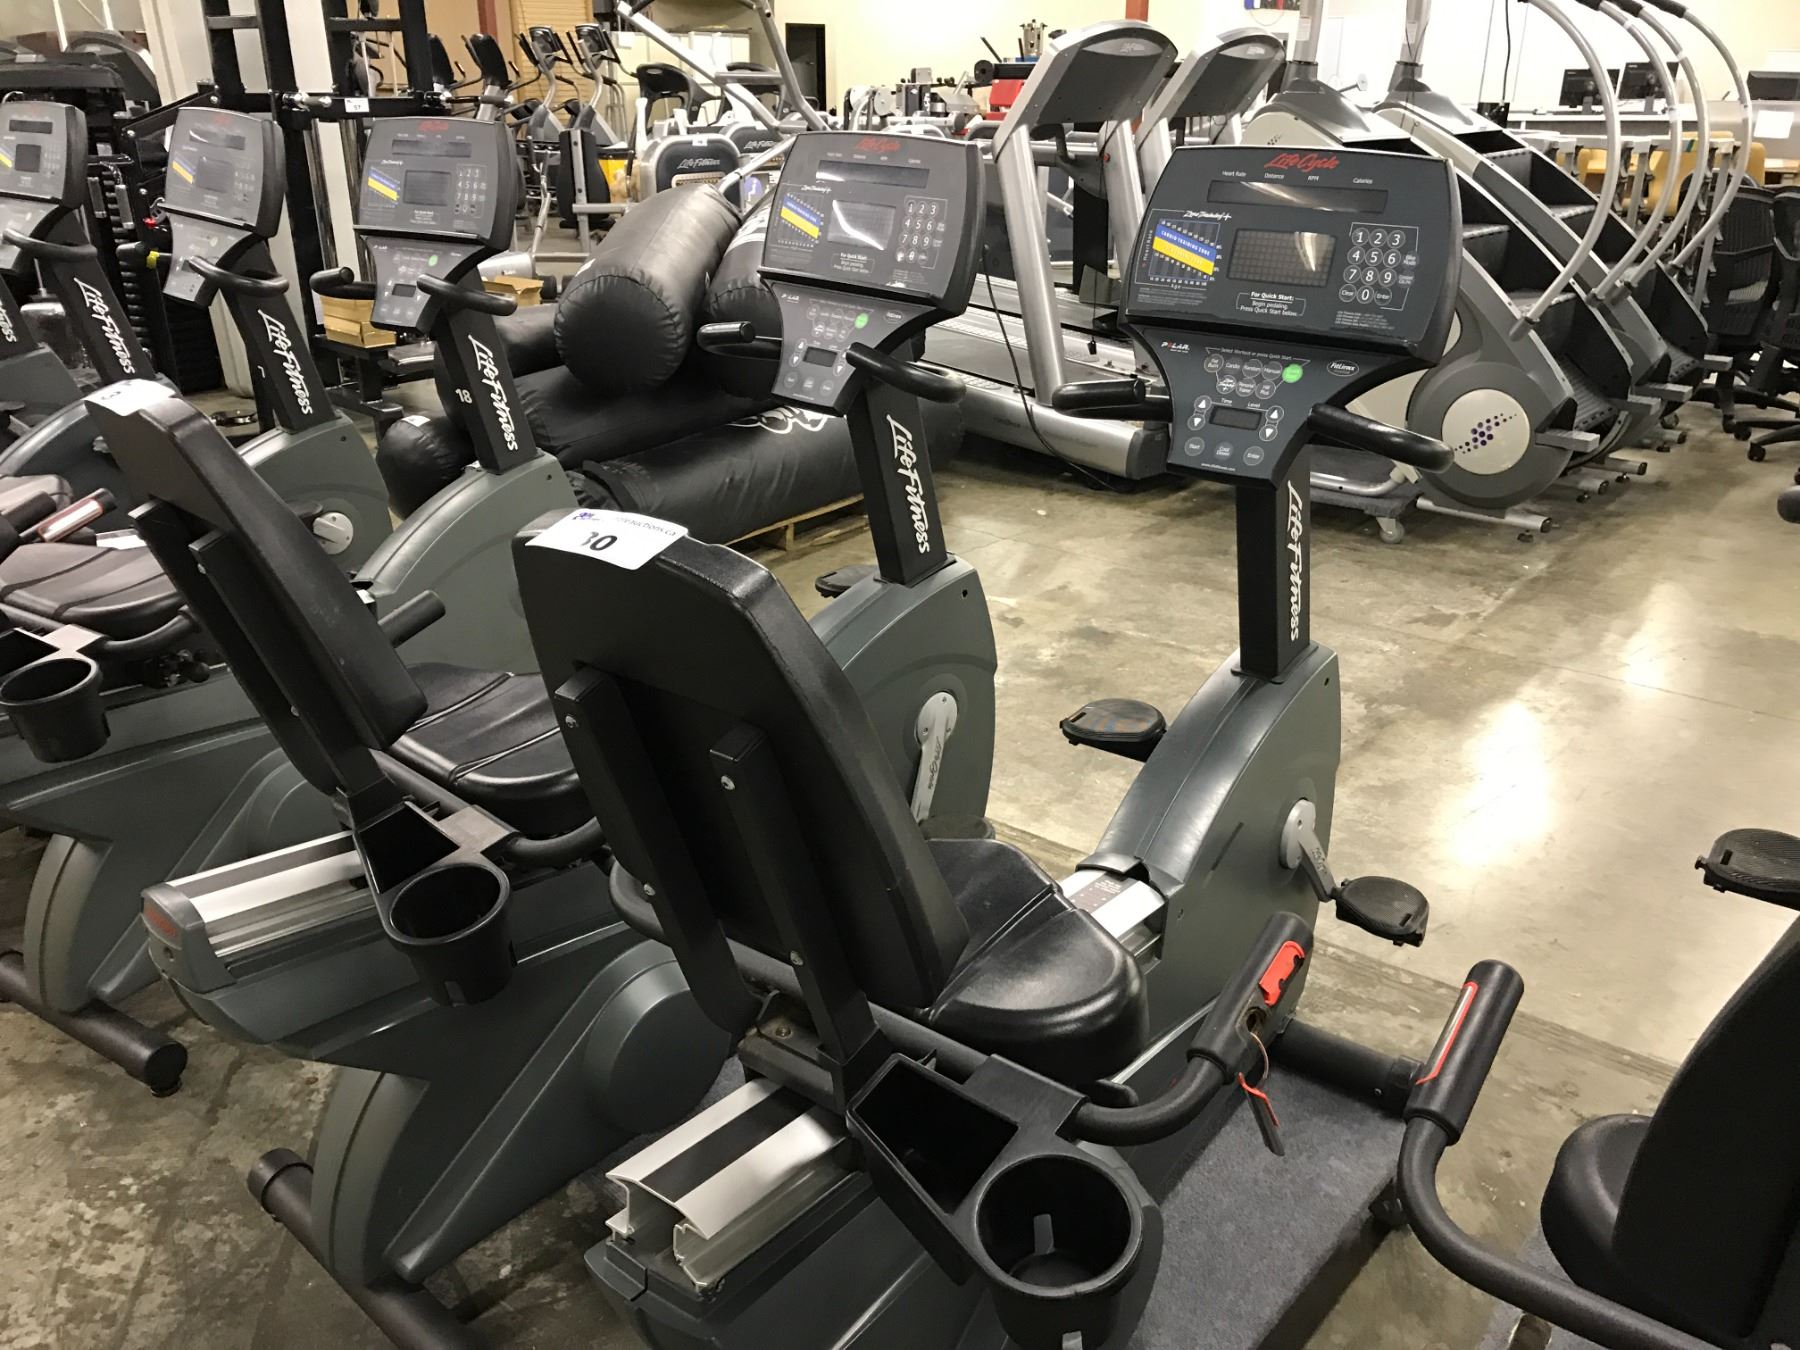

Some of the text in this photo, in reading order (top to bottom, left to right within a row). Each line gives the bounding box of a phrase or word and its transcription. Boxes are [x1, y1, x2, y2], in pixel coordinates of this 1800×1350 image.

[908, 203, 937, 215] 1 2 3
[904, 218, 911, 228] 4
[915, 220, 922, 230] 5
[926, 221, 933, 231] 6
[902, 235, 908, 244] 7
[912, 236, 919, 245] 8
[923, 237, 930, 247] 9
[1356, 231, 1401, 246] 1 2 3
[1352, 250, 1396, 265] 4 5 6
[1348, 268, 1358, 280] 7
[1365, 270, 1374, 282] 8
[1383, 271, 1392, 284] 9
[1261, 292, 1277, 300] Quick
[1341, 289, 1354, 297] Clear
[1361, 288, 1370, 301] 0
[1252, 300, 1266, 308] Begin
[1254, 306, 1268, 314] Quick
[455, 388, 473, 404] 18
